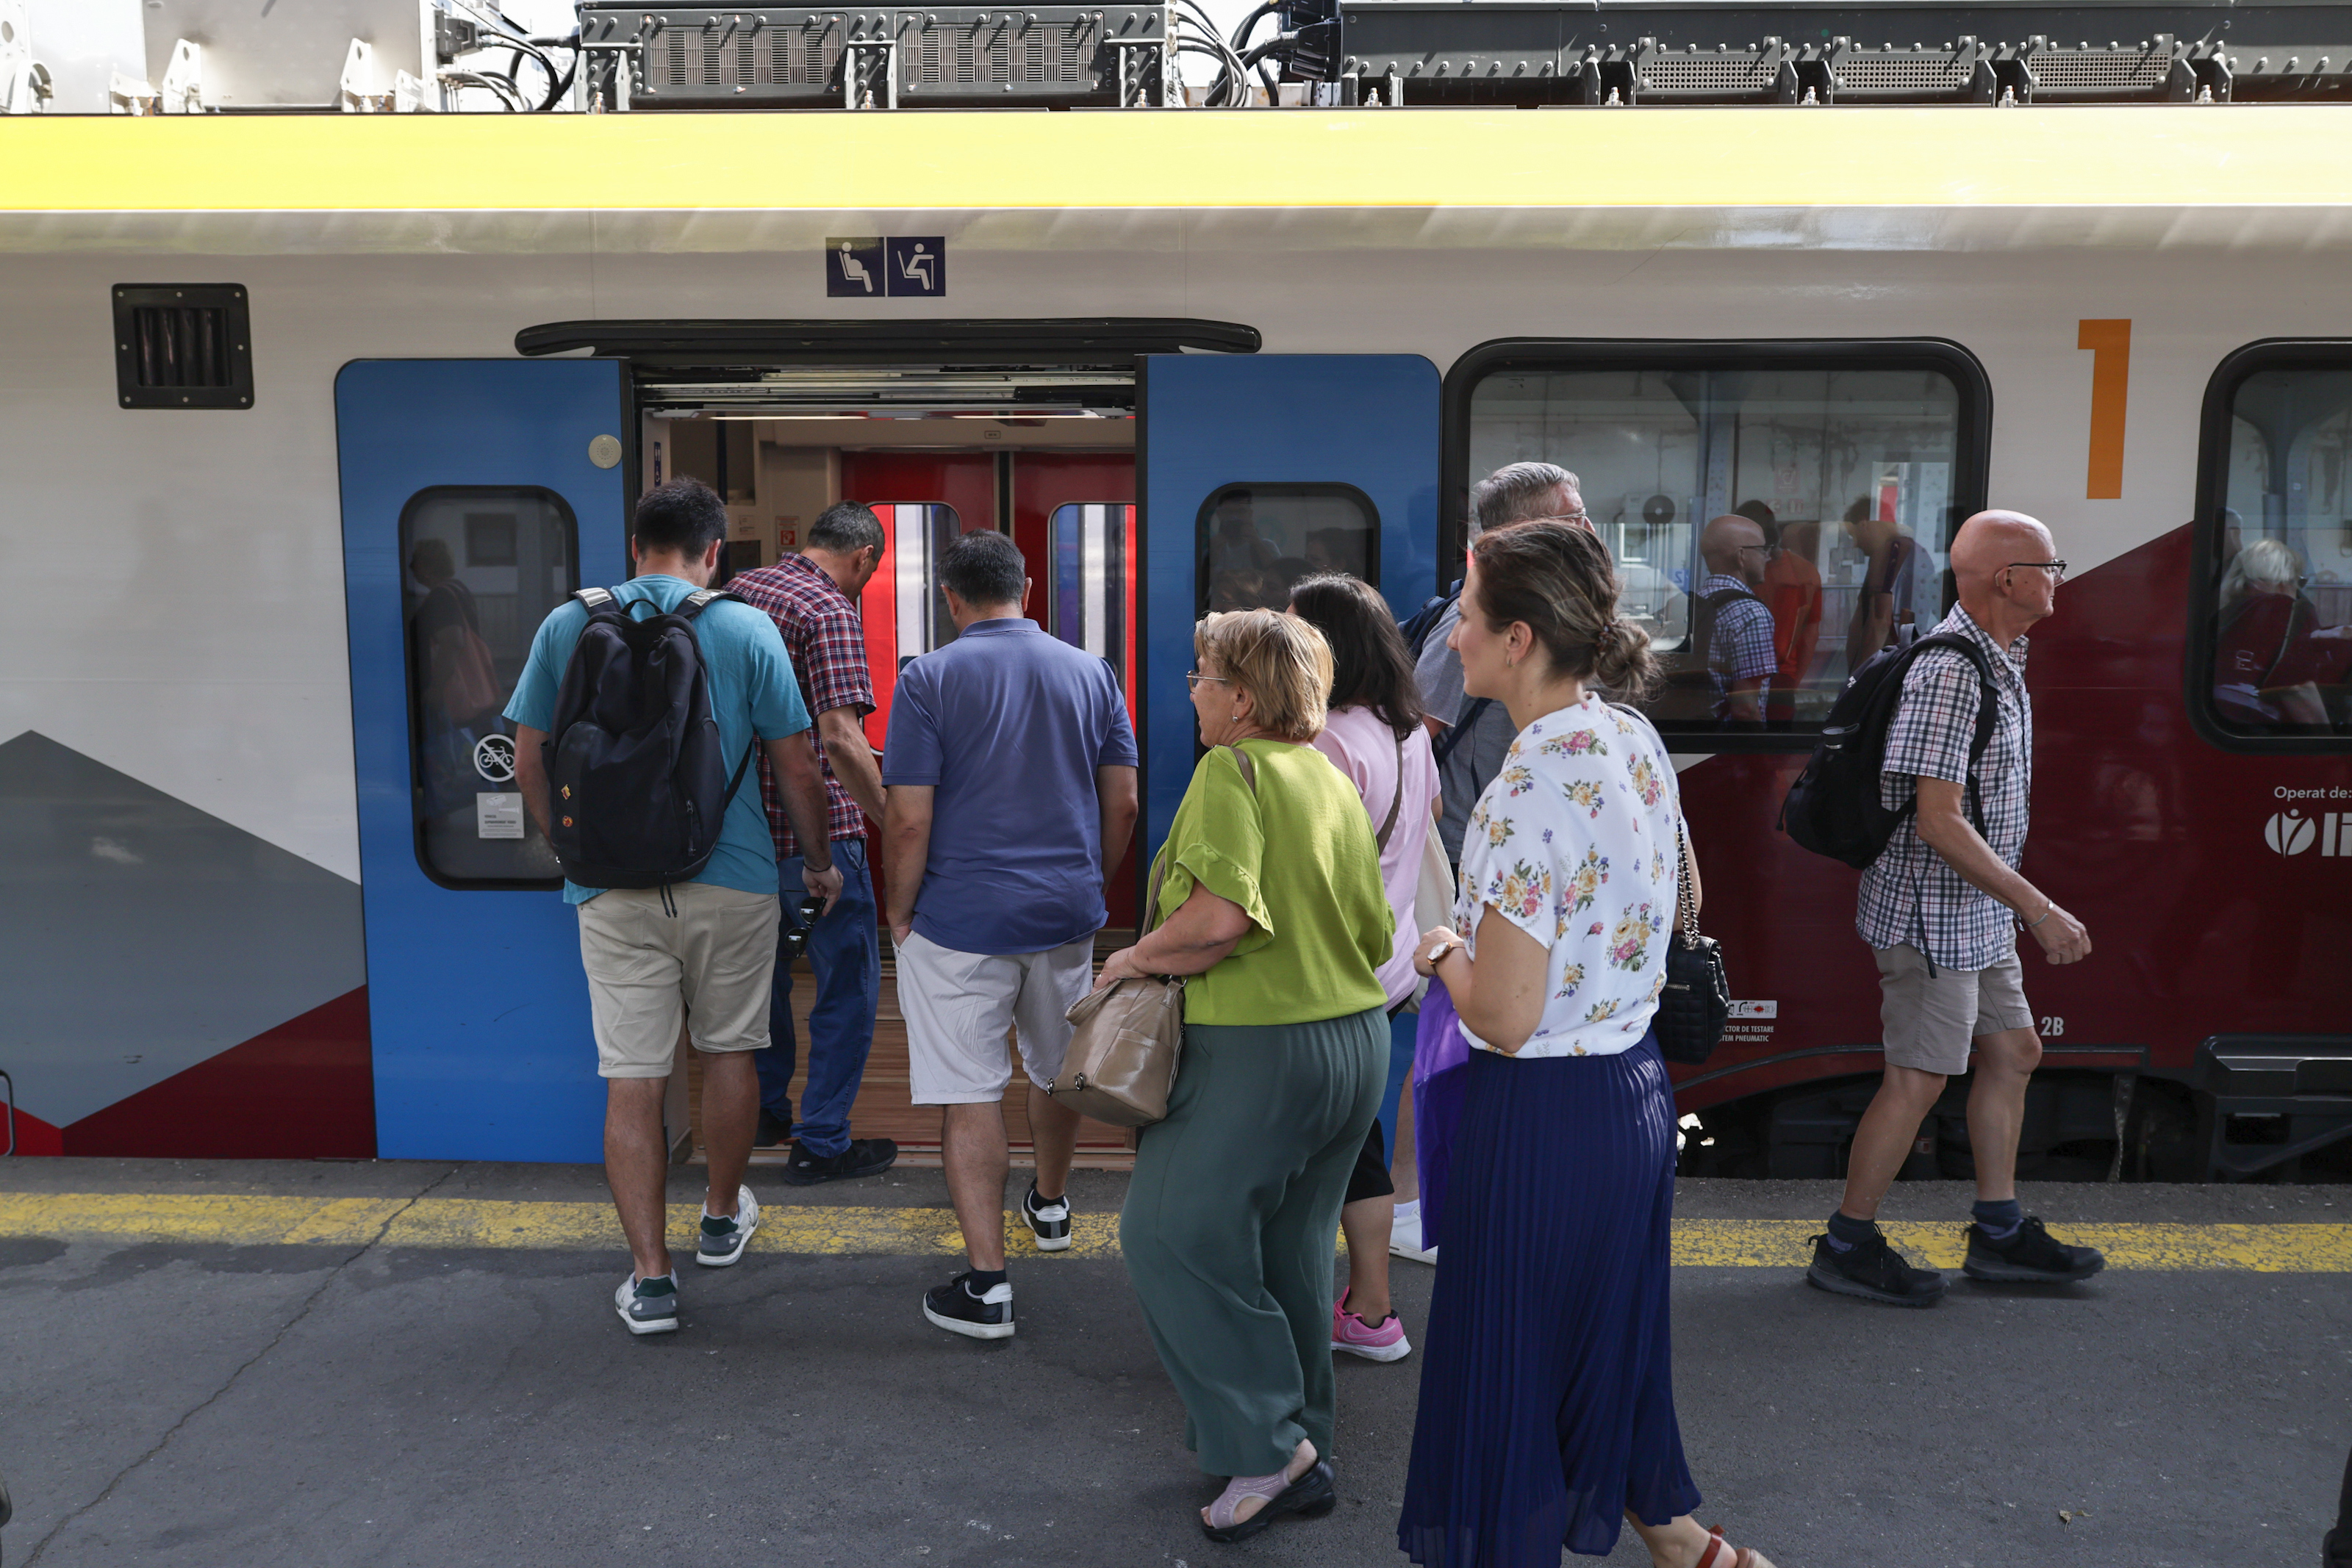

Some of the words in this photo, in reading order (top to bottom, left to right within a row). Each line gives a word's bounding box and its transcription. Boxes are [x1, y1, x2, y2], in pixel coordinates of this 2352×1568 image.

[2077, 319, 2132, 499] 1
[2274, 786, 2326, 802] Operat
[2329, 785, 2352, 799] de:
[2040, 1016, 2064, 1036] 2B
